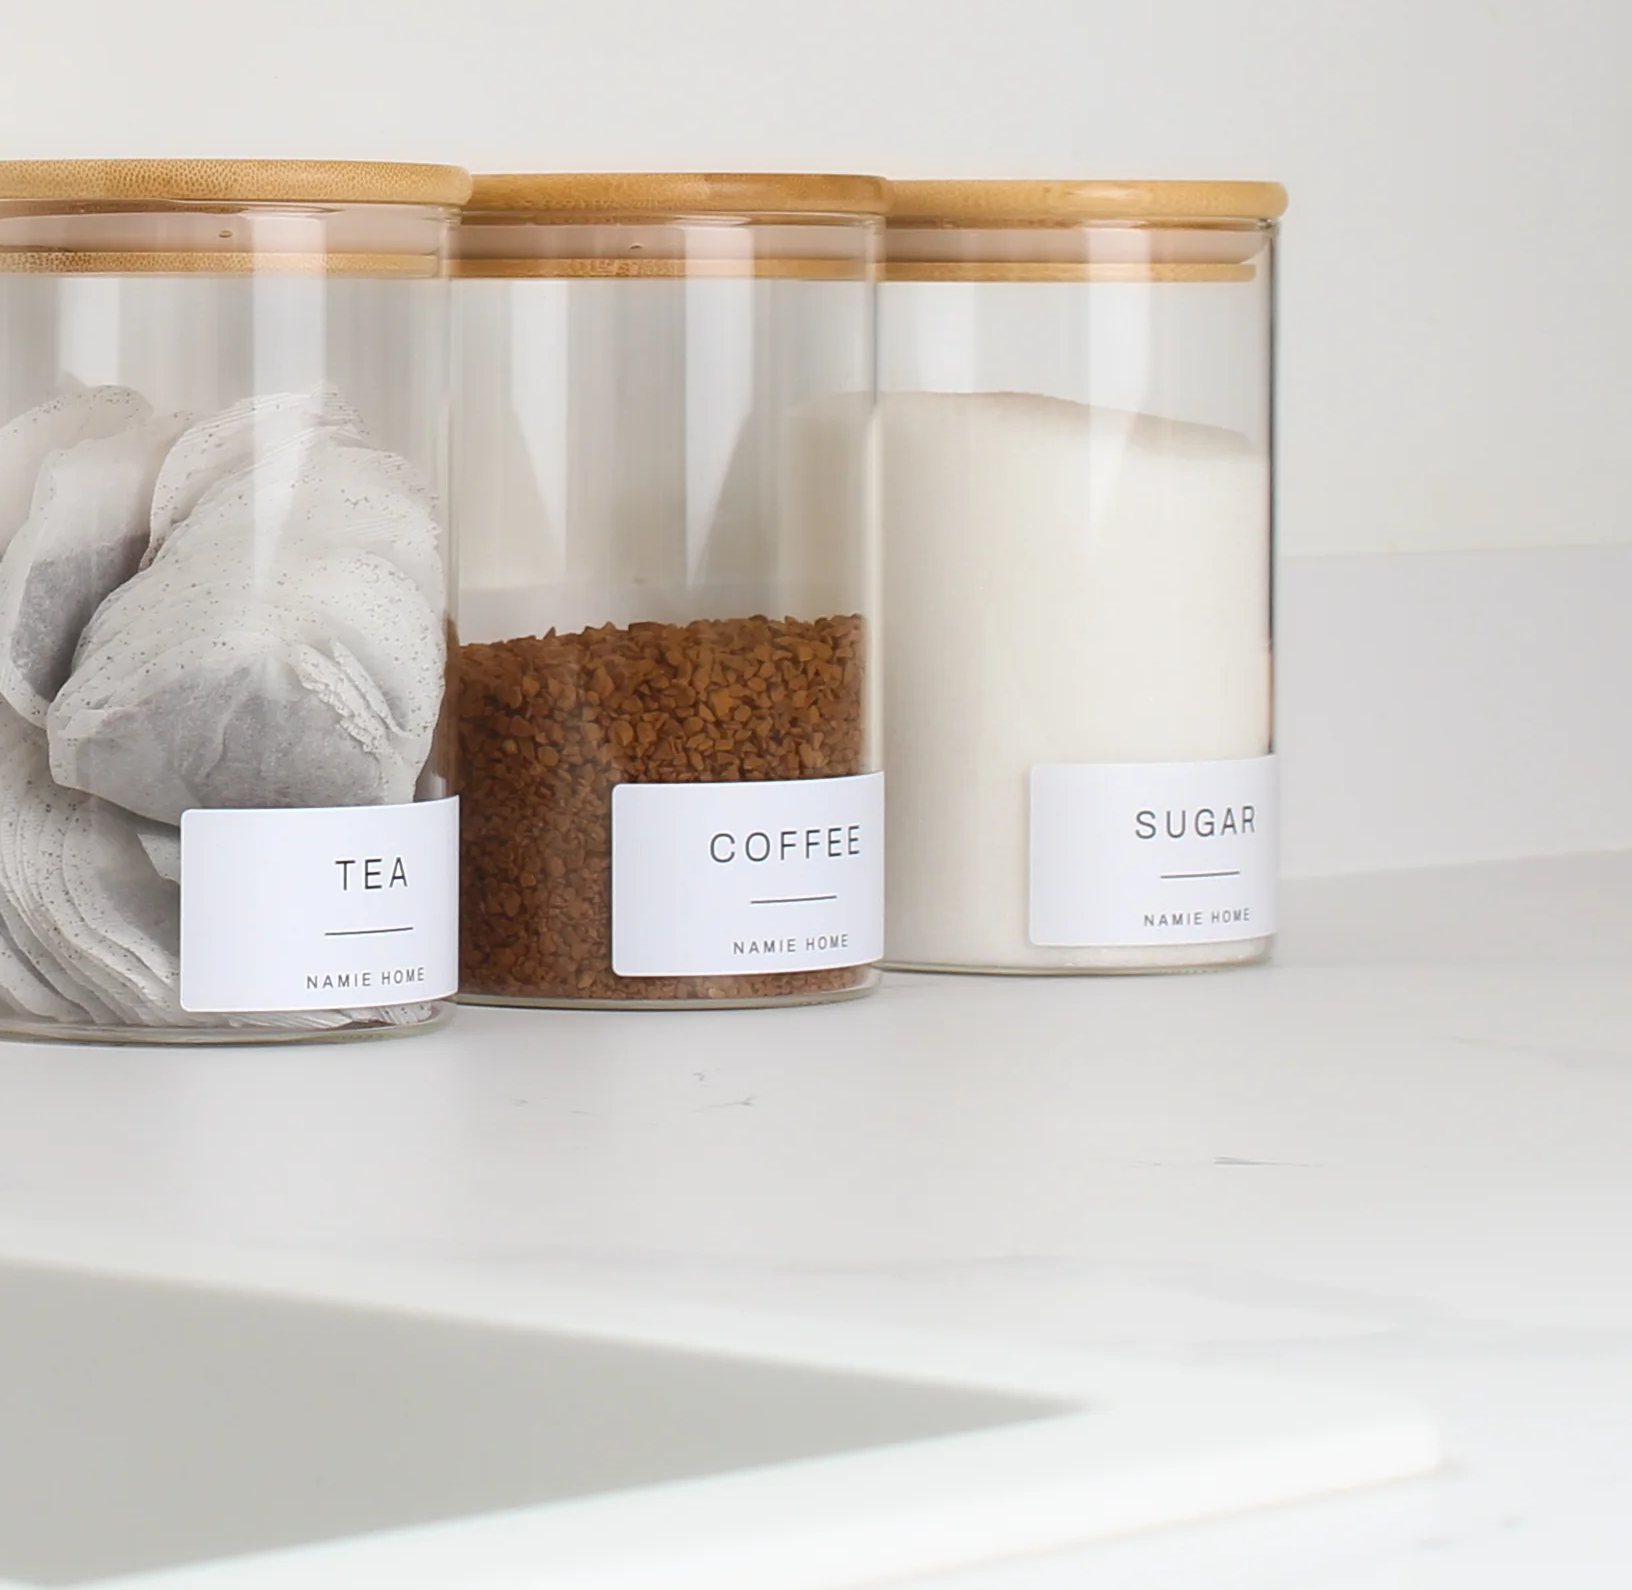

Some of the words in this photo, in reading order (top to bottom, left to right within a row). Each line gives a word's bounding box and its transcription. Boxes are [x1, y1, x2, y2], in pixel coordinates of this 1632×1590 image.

[1134, 805, 1255, 840] SUGAR
[709, 824, 861, 864] COFFEE
[334, 856, 408, 892] TEA
[1143, 911, 1203, 927] NAMIE
[1211, 907, 1250, 924] HOME
[733, 938, 796, 955] NAMIE
[805, 933, 848, 951] HOME
[306, 972, 372, 990] NAMIE
[381, 966, 425, 986] HOME
